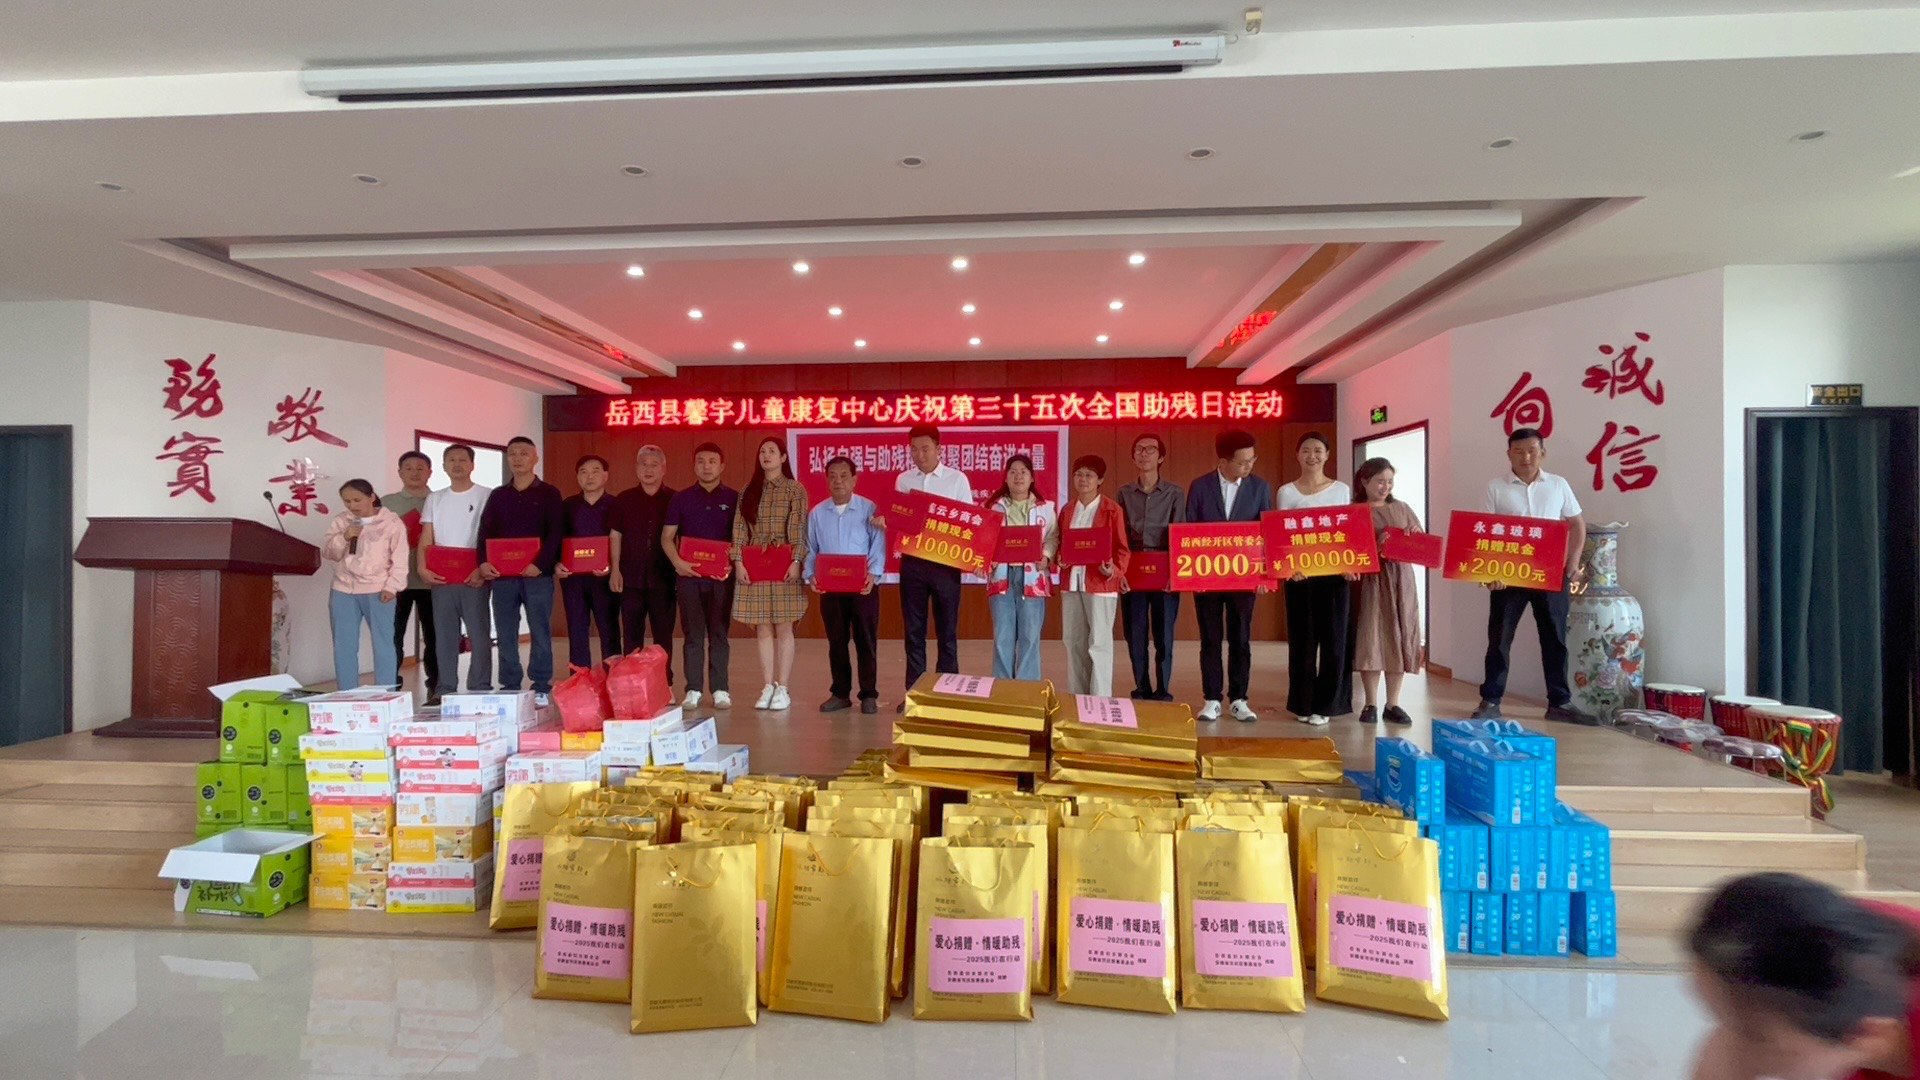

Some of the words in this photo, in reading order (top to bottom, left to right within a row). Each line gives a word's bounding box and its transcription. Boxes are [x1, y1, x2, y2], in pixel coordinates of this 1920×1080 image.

[605, 391, 1284, 426] 岳西县馨宇儿童康复中心庆祝第三十五次全国助残日活动
[925, 517, 974, 541] 捐赠现金
[1283, 513, 1348, 530] 融鑫地产
[1473, 521, 1543, 539] 永鑫玻璃
[1181, 535, 1264, 548] 岳西经开区管委会
[1290, 531, 1346, 546] 捐赠现金
[1475, 538, 1535, 556] 捐赠现金
[901, 532, 985, 568] ¥10000元
[1273, 549, 1371, 571] ¥10000元
[1177, 553, 1266, 577] 2000元
[1459, 557, 1545, 583] ¥2000元
[550, 916, 627, 939] 爱心捐赠·情暖助残
[1075, 913, 1161, 936] 爱心捐赠·情暖助残
[1200, 917, 1286, 936] 爱心捐赠·情暖助残
[1335, 910, 1429, 938] 爱心捐赠·情暖助残
[935, 934, 1021, 951] 爱心捐赠·情暖助残
